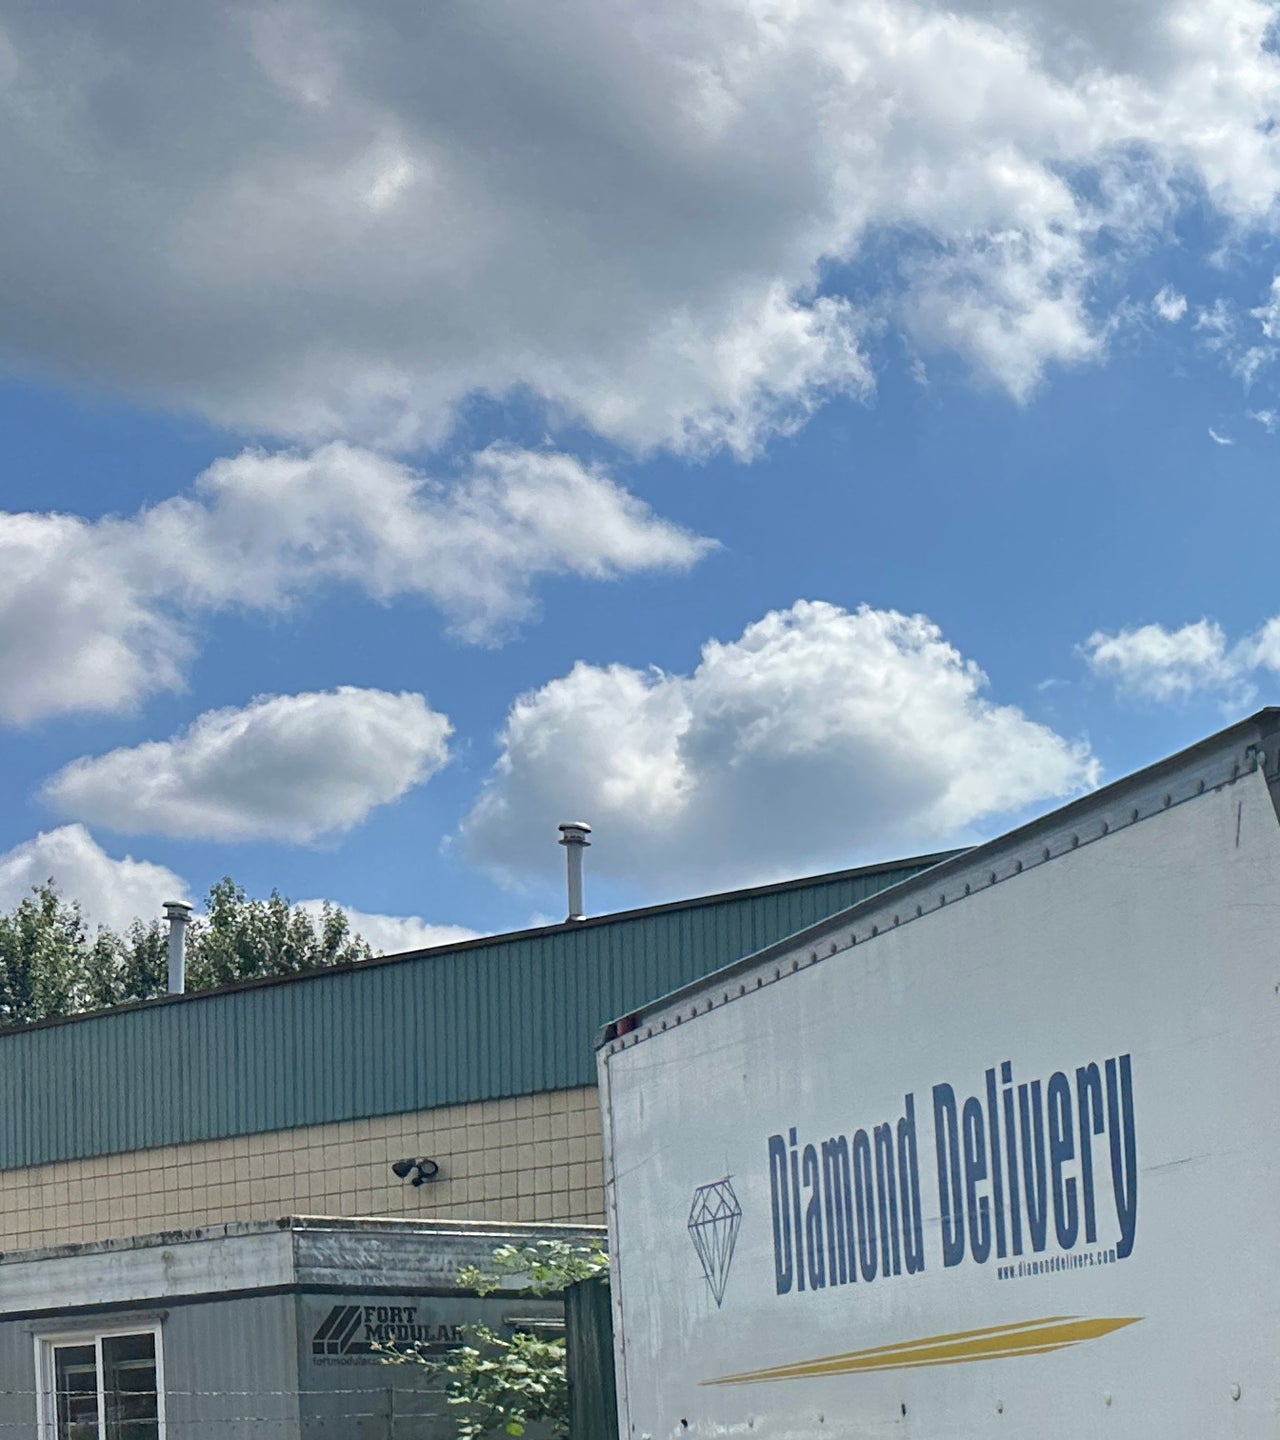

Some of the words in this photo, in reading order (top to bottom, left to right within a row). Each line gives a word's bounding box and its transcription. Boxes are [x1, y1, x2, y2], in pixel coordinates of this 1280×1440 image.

[767, 1092, 925, 1296] Diamond
[931, 1053, 1137, 1267] Delivery
[996, 1248, 1117, 1281] www.diamonddelivers.com
[363, 1305, 418, 1324] FORT
[363, 1323, 465, 1342] MODULAR
